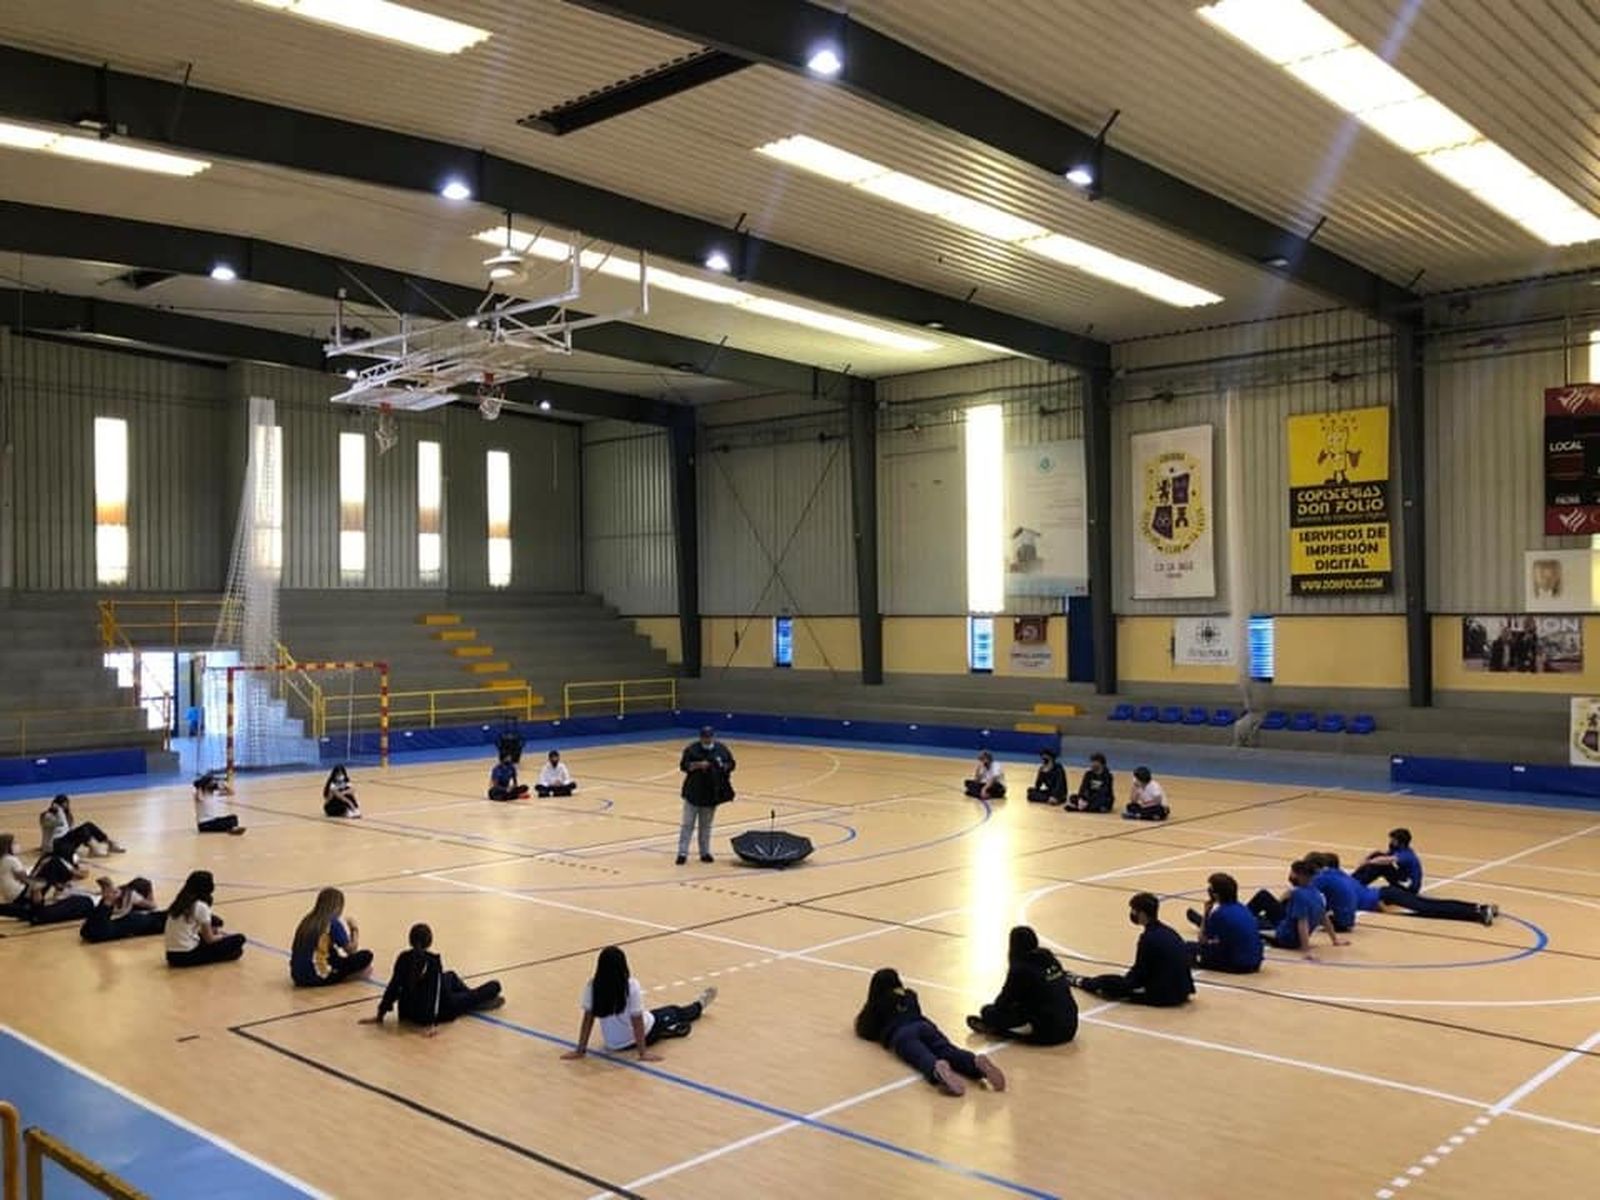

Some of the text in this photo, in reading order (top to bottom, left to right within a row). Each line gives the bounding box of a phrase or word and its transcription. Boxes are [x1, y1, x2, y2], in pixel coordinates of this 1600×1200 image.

[1549, 440, 1583, 452] LOCAL
[1298, 498, 1384, 515] DON FOLIO
[1299, 526, 1387, 542] SERVICIOS DE
[1306, 541, 1379, 556] IMPRESIÓN
[1315, 558, 1369, 571] DIGITAL
